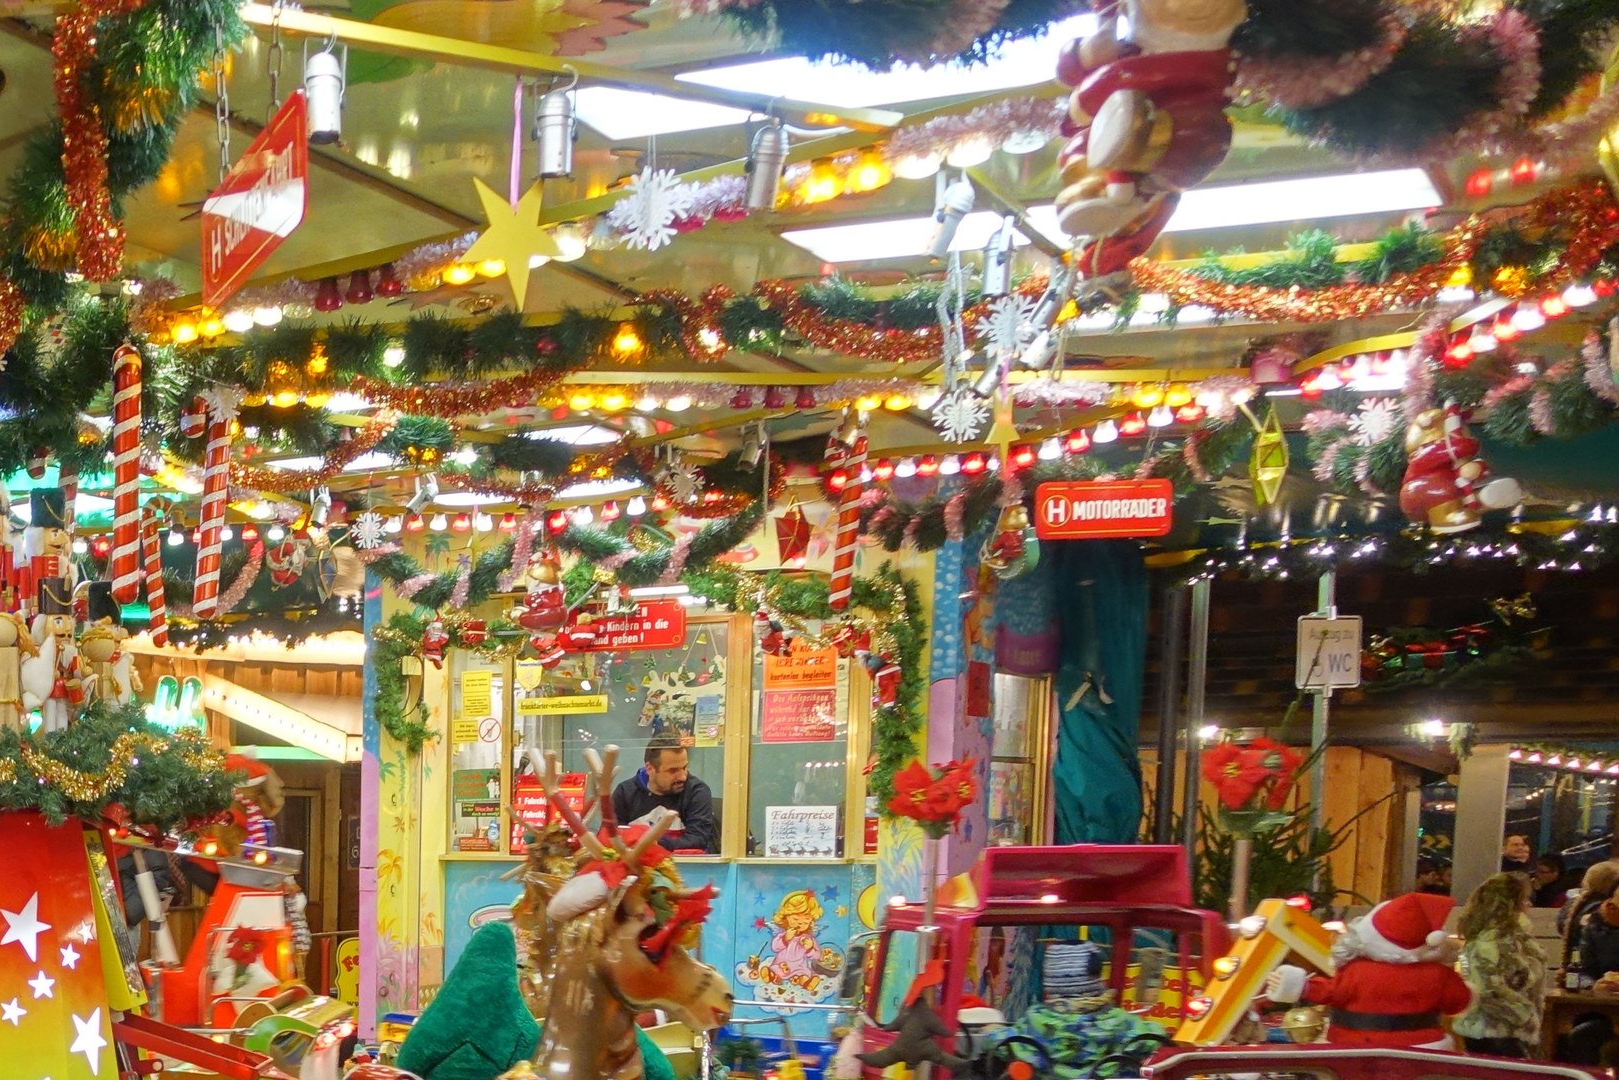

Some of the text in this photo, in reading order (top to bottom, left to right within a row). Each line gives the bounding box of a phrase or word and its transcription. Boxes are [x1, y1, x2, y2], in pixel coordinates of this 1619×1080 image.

[1047, 499, 1066, 523] H
[606, 620, 640, 632] Kindern
[642, 619, 652, 630] in
[654, 617, 670, 630] die
[591, 634, 609, 645] and
[1328, 653, 1352, 672] WC
[771, 808, 835, 823] Fahrpreise
